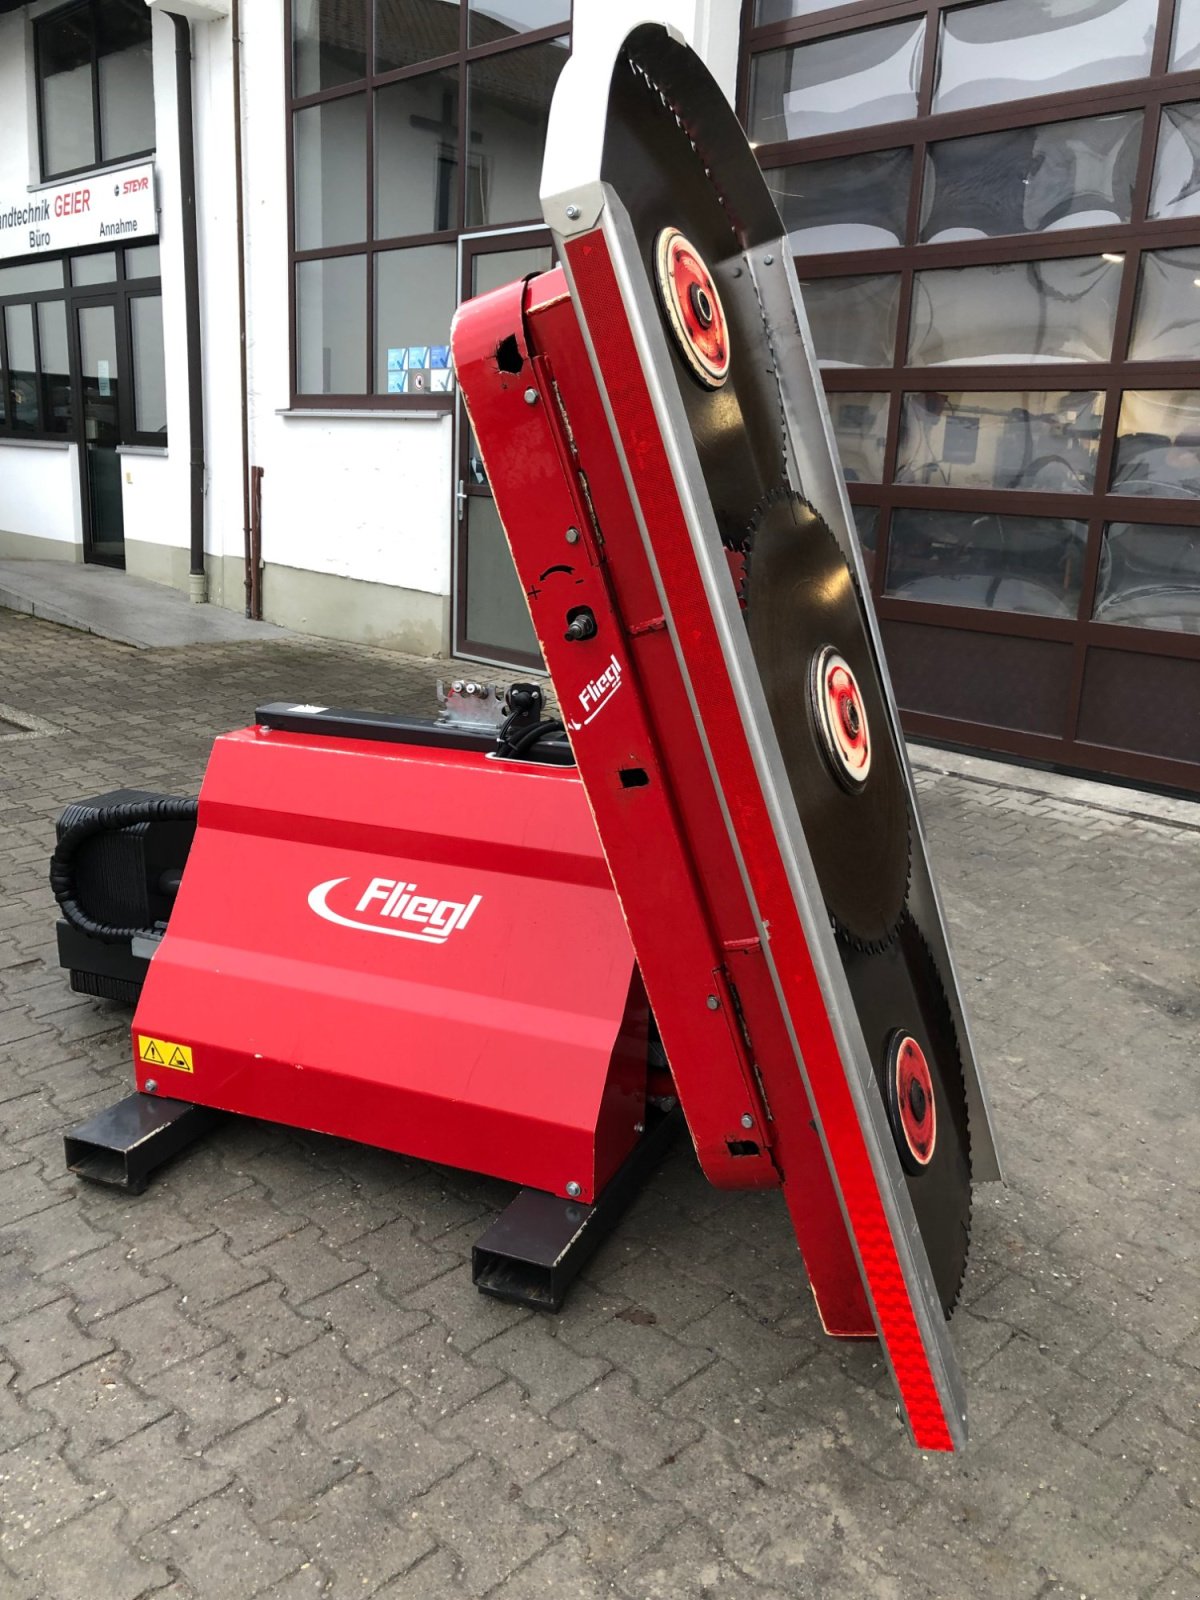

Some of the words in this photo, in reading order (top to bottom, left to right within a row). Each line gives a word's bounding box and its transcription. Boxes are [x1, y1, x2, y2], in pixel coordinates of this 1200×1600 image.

[123, 177, 149, 194] STEYR
[54, 189, 91, 217] GEIER
[29, 229, 51, 248] Büro
[99, 218, 138, 237] Annahme
[578, 654, 622, 712] Fliegl
[355, 877, 483, 937] Fliegl
